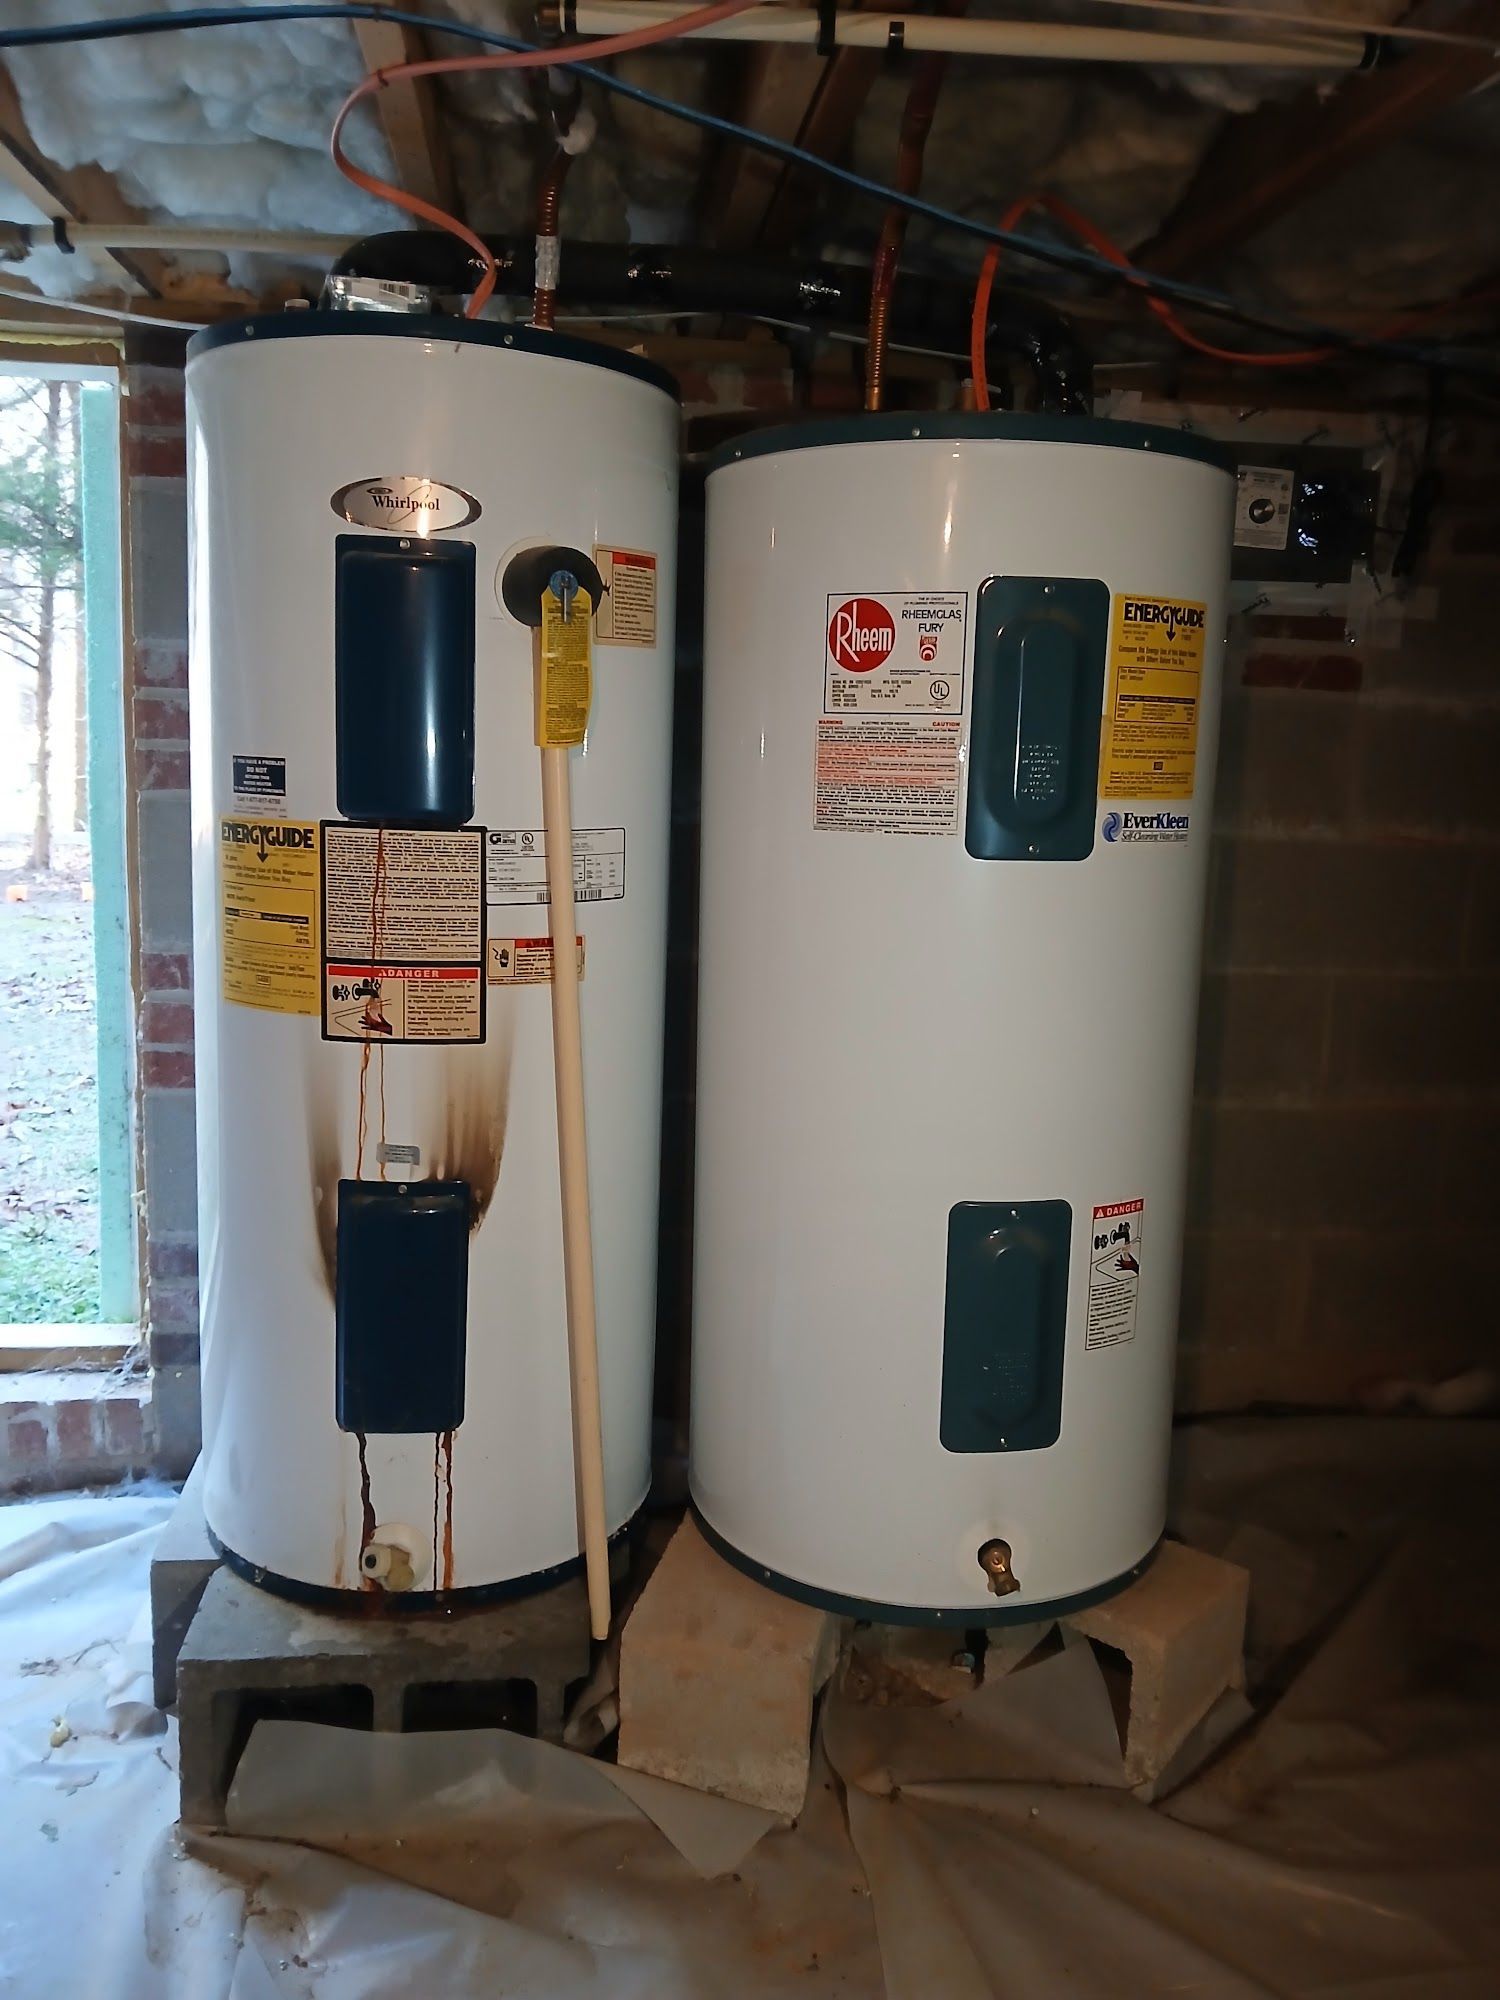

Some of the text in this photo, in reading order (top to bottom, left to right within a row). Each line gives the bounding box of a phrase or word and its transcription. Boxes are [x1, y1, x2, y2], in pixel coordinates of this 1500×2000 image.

[373, 495, 440, 512] Whirlpool
[901, 609, 962, 620] RHEEMGLAS
[1124, 602, 1205, 629] ENERGYGUIDE
[836, 601, 892, 662] Rheem
[918, 622, 945, 633] FURY
[1122, 812, 1189, 829] EverKleen
[221, 821, 315, 849] ENERGYGUIDE
[1122, 832, 1158, 841] Self-Cleaning
[387, 968, 440, 978] DANGER
[1106, 1201, 1142, 1217] DANGER
